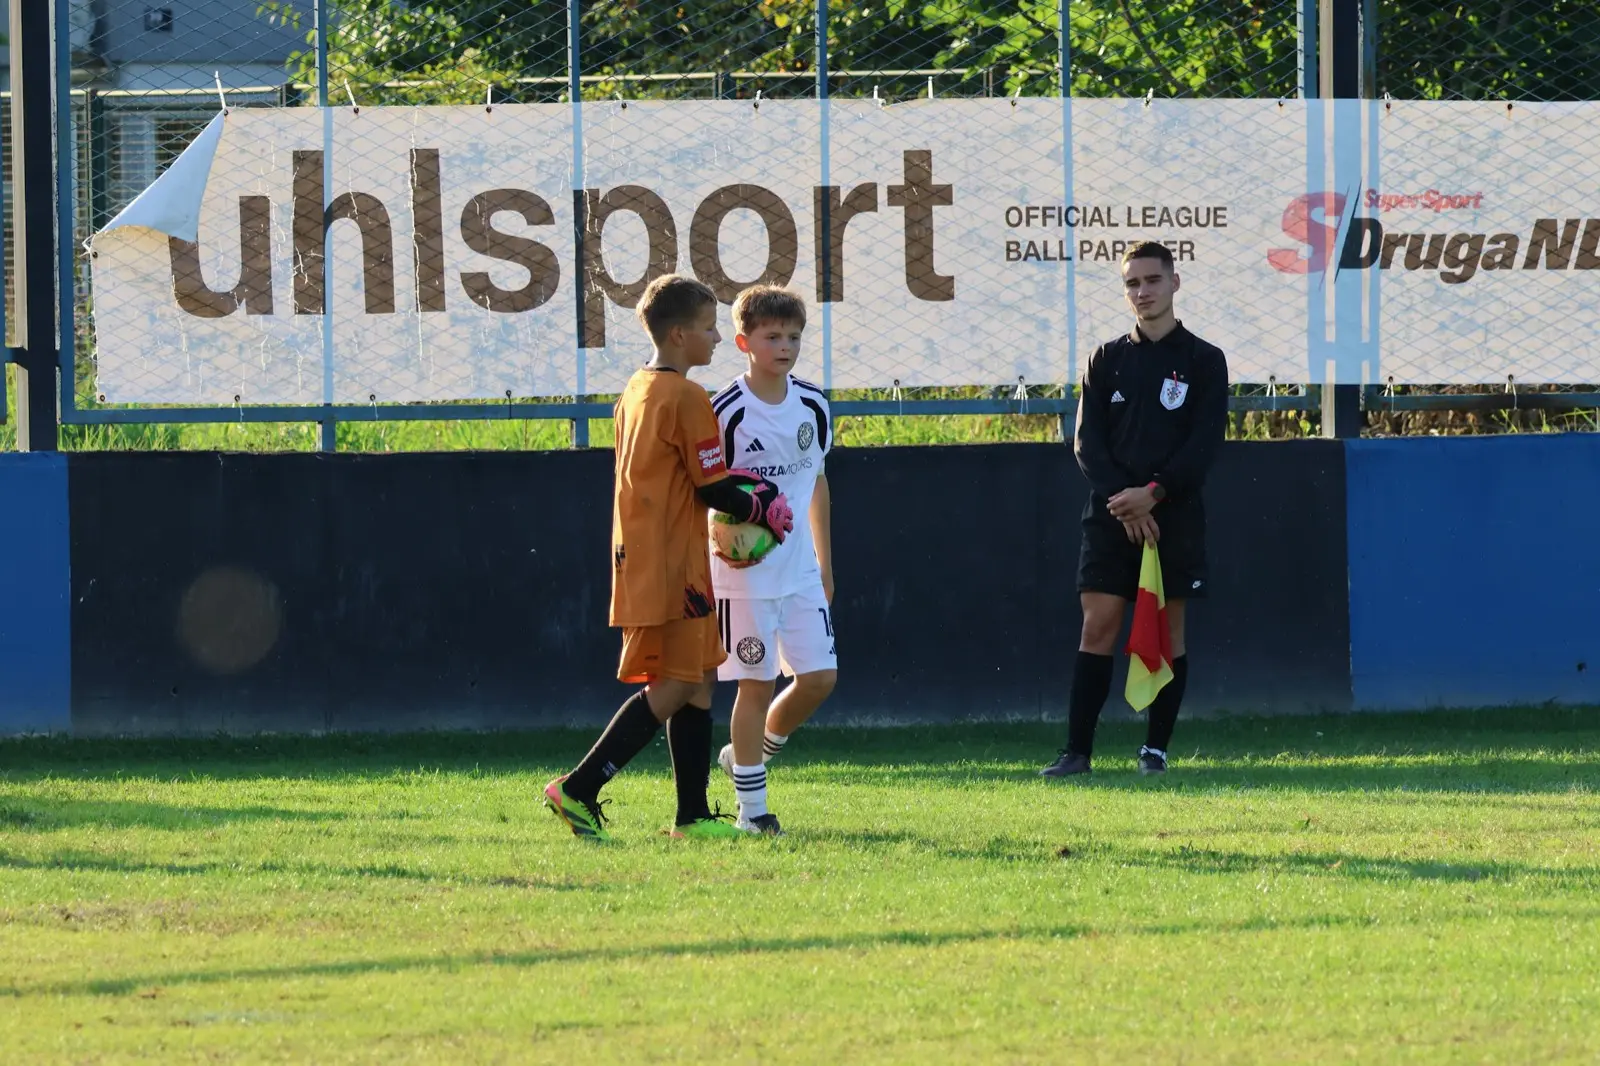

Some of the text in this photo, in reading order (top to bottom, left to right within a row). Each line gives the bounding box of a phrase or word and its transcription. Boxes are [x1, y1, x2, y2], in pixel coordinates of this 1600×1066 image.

[1005, 206, 1228, 228] OFFICIAL LEAGUE
[168, 148, 955, 349] uhlsport
[1005, 240, 1072, 262] BALL
